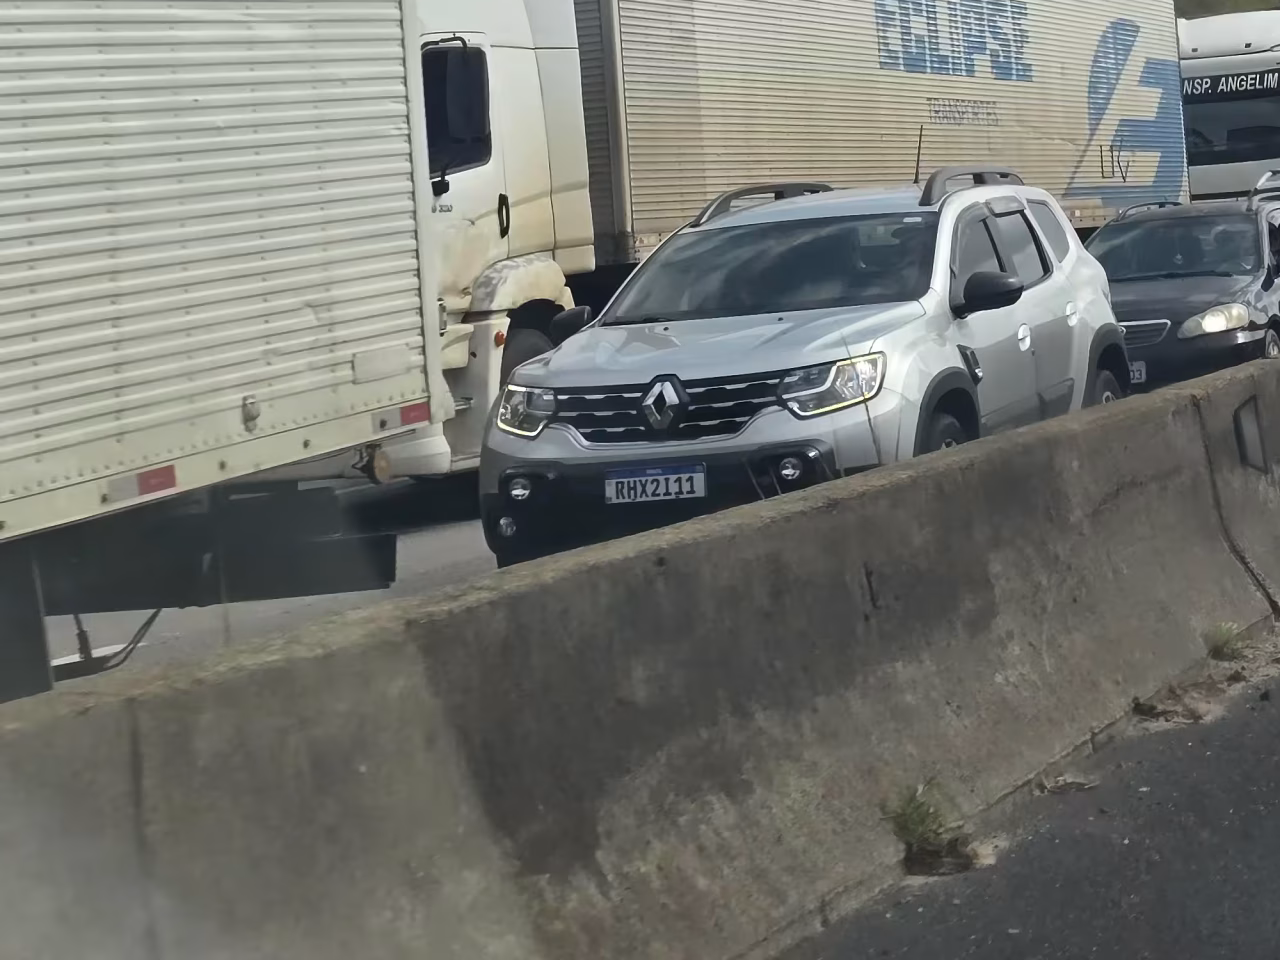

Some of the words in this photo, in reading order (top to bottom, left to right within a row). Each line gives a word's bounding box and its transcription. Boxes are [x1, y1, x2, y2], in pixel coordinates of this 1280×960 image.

[1183, 78, 1212, 96] NSP.
[1217, 72, 1279, 94] ANGELIM
[615, 475, 696, 500] RHX2I11
